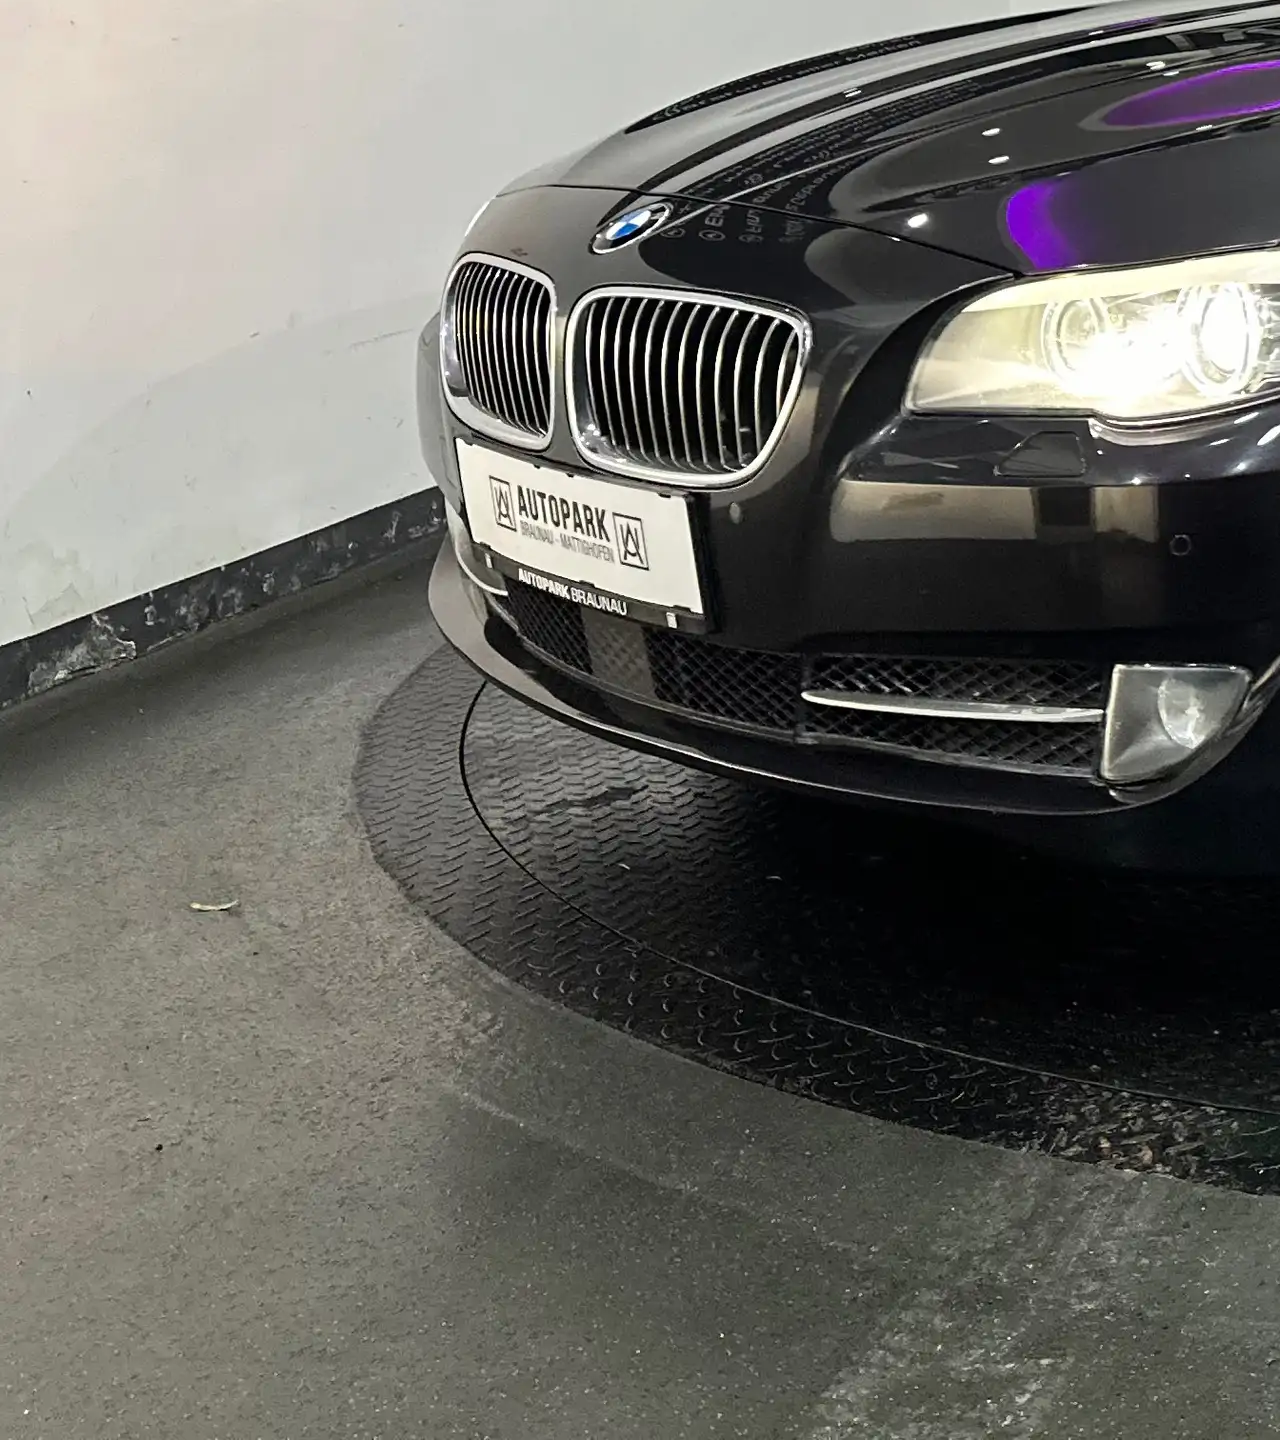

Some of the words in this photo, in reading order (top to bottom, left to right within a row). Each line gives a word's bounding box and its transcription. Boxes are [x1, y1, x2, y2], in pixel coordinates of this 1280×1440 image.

[517, 484, 610, 542] AUTOPARK
[518, 568, 571, 600] AUTOPARK
[570, 585, 628, 616] BRAUNAU
